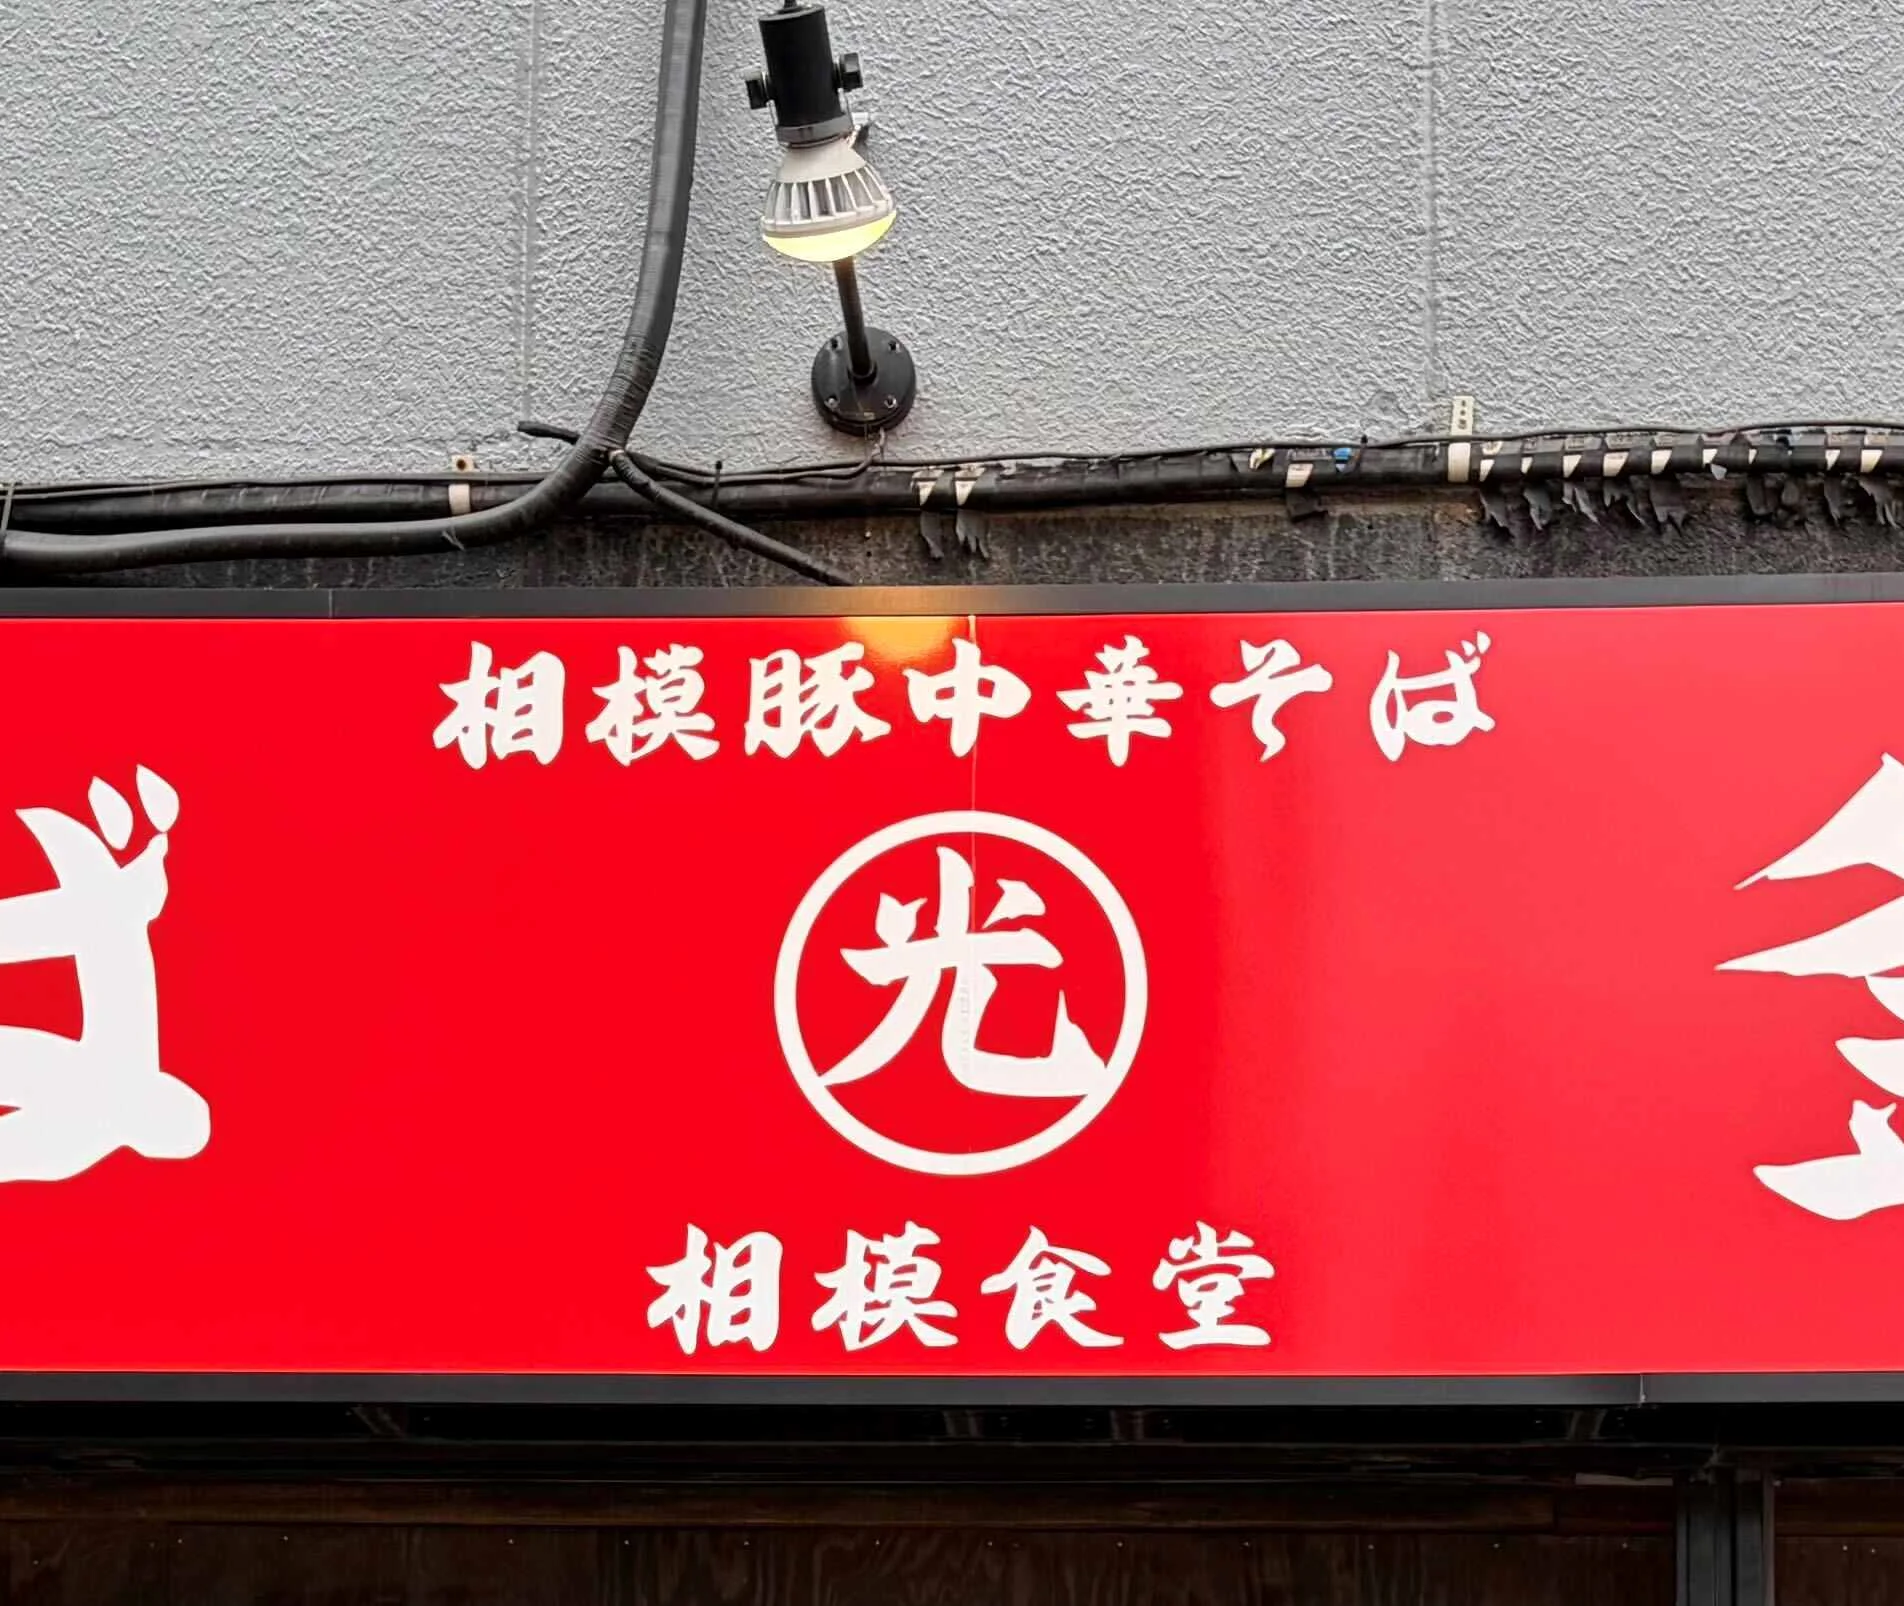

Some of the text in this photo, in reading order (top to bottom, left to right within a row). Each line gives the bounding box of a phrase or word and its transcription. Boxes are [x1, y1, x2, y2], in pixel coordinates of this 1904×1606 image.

[432, 632, 1496, 770] 相模豚中華そば
[818, 843, 1114, 1100] 光
[645, 1221, 1276, 1355] 相模食堂
